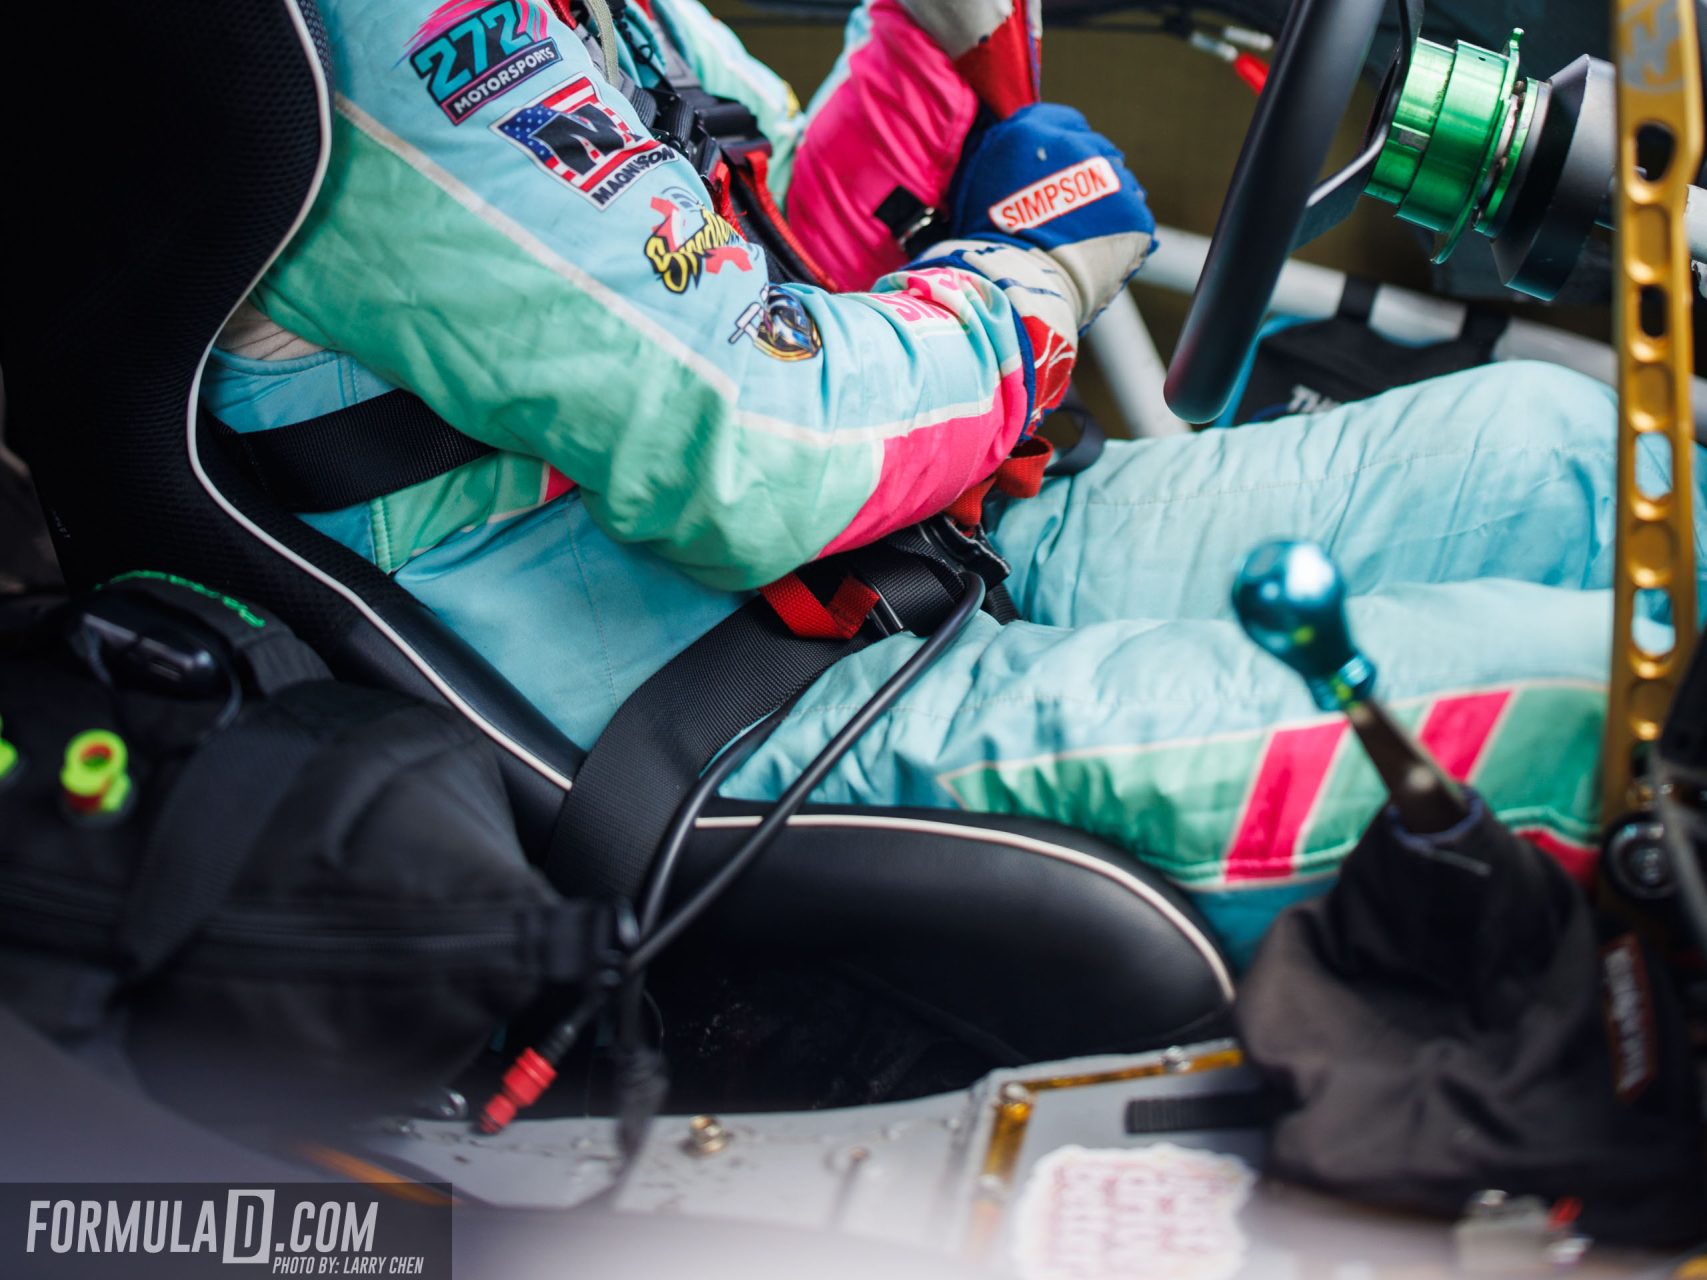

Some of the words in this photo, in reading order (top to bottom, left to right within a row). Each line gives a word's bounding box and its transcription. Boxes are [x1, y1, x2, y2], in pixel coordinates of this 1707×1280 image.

[413, 0, 533, 102] 272
[452, 46, 556, 115] MOTORSPORTS
[1000, 165, 1109, 229] SIMPSON
